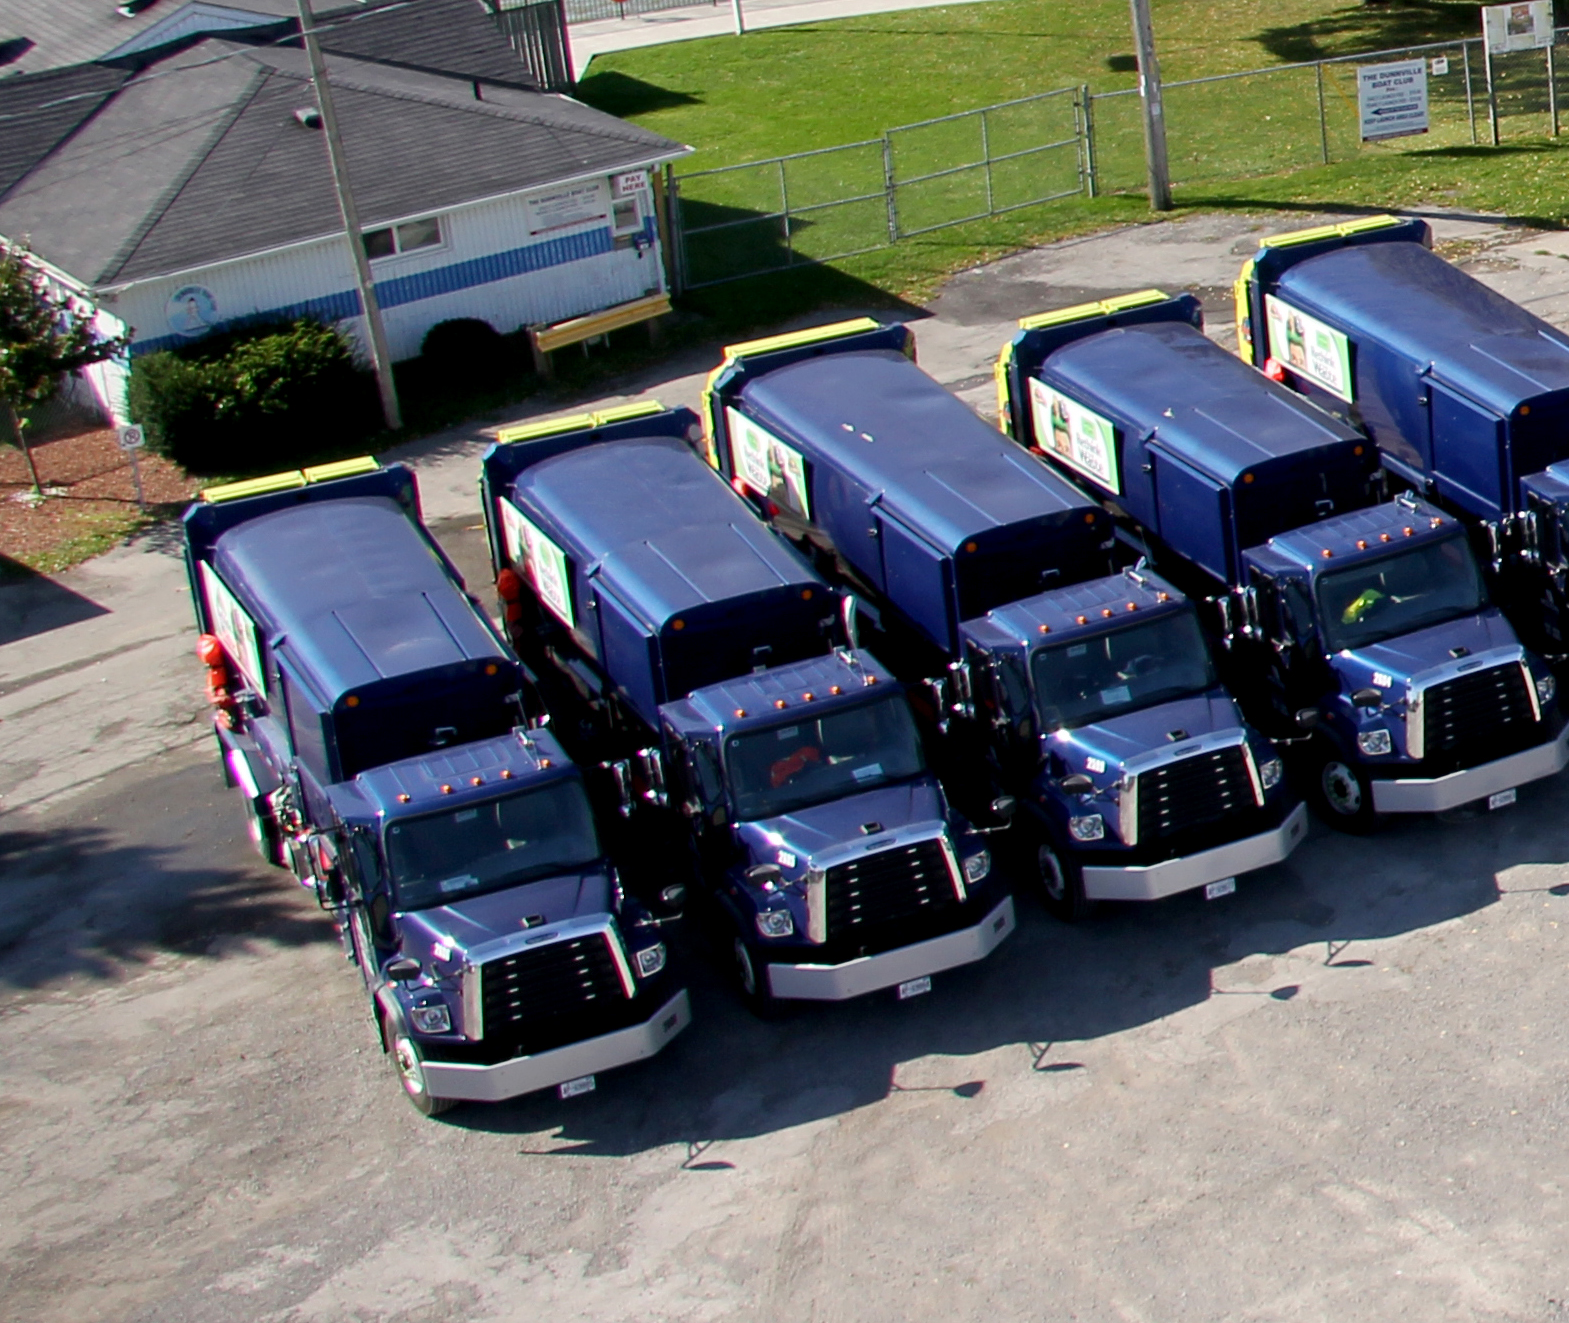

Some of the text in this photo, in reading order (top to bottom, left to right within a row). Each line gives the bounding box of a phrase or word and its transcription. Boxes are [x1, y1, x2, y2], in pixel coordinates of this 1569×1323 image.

[1363, 67, 1422, 82] THE DUNNVILLE
[1372, 76, 1414, 89] BOAT CLUB
[626, 174, 641, 184] PAY
[622, 181, 645, 192] HERE
